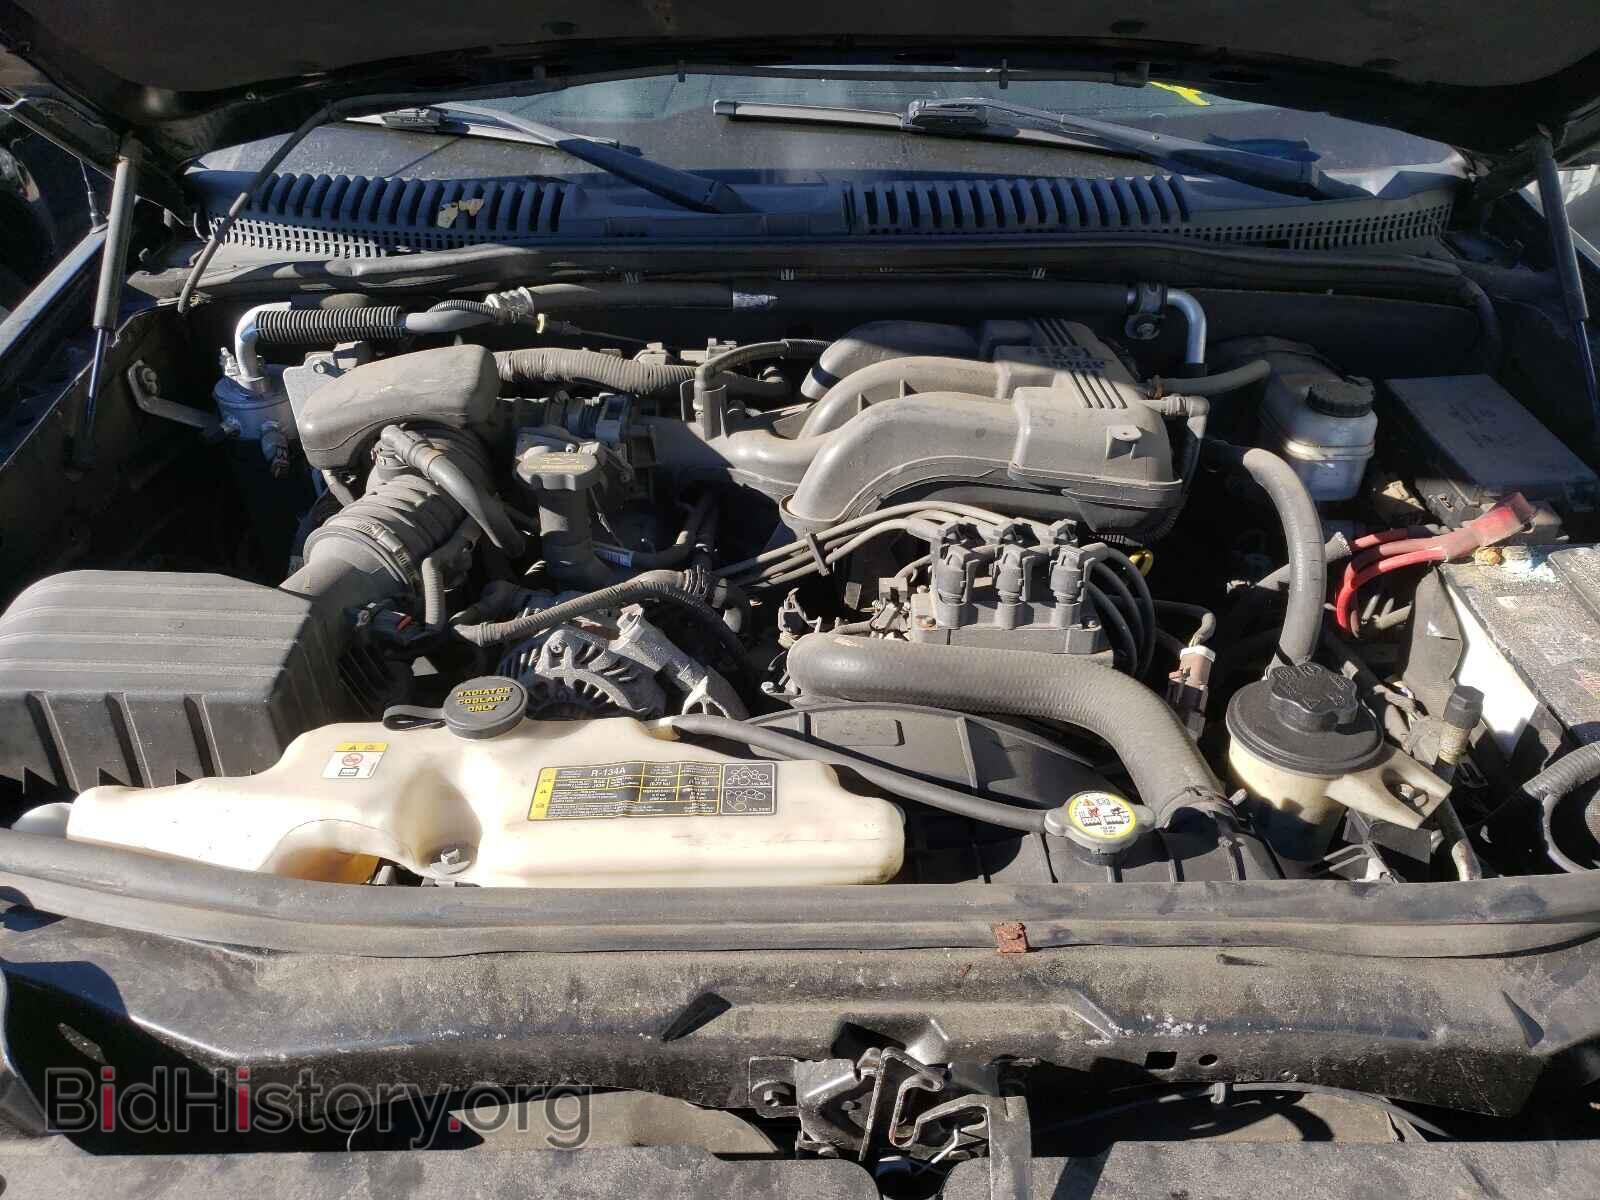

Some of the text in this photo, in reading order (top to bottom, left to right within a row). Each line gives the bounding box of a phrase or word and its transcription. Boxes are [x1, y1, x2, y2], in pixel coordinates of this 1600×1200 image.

[457, 687, 513, 697] RADIATOR
[457, 695, 511, 705] COOLANT
[467, 704, 497, 713] ONLY
[591, 767, 626, 777] R-134A
